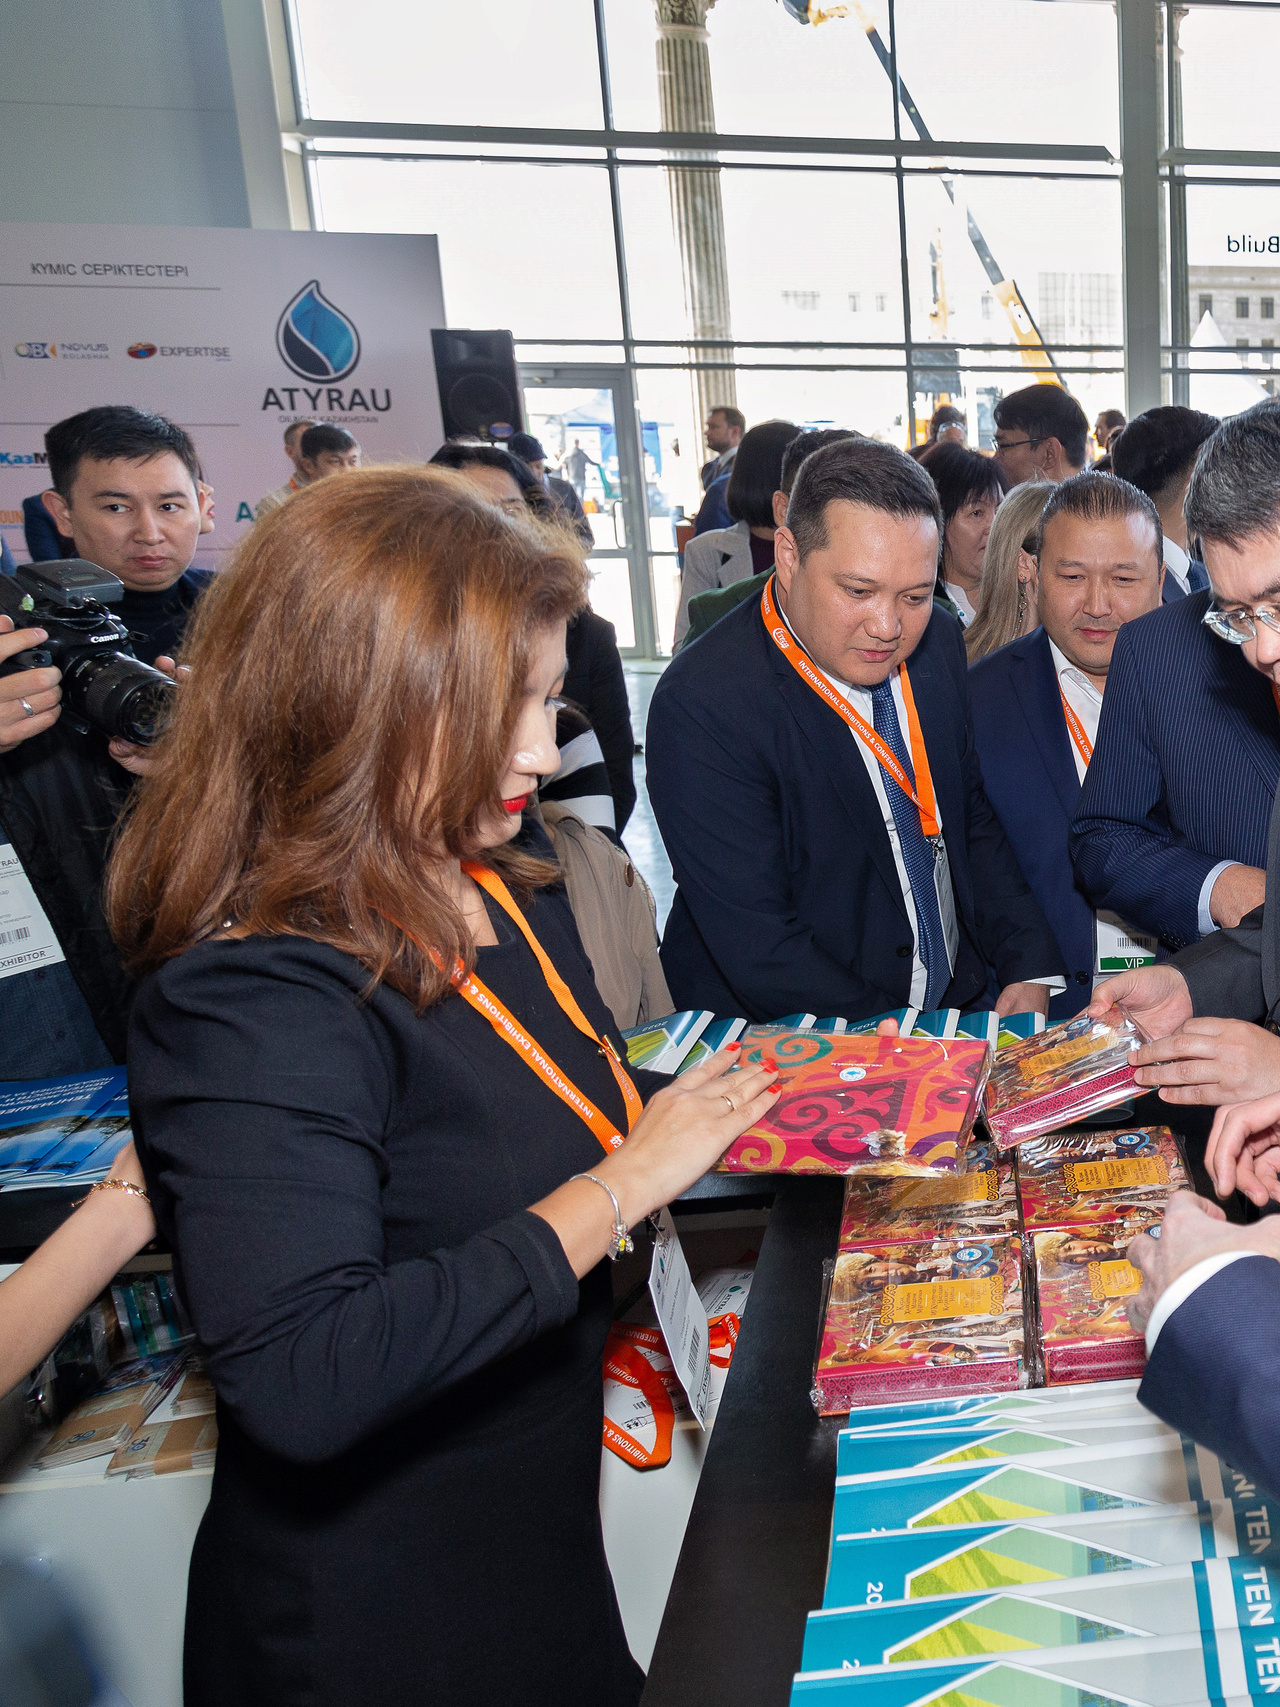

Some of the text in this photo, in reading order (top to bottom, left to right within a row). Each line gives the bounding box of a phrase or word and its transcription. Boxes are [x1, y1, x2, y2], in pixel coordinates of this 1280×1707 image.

[60, 343, 109, 351] NOVUS
[160, 346, 231, 358] EXPERTISE
[262, 387, 392, 412] ATYRAU
[90, 633, 119, 643] Canon
[798, 660, 840, 706] INTERNATIONAL
[839, 703, 872, 739] EXHIBITIONS
[874, 742, 905, 782] CONFERENCES
[1124, 957, 1145, 969] VIP
[476, 993, 532, 1051] EXHIBITIONS
[530, 1047, 594, 1119] INTERNATIONAL
[611, 1434, 648, 1464] HIBITIONS
[1243, 1566, 1275, 1626] TEN
